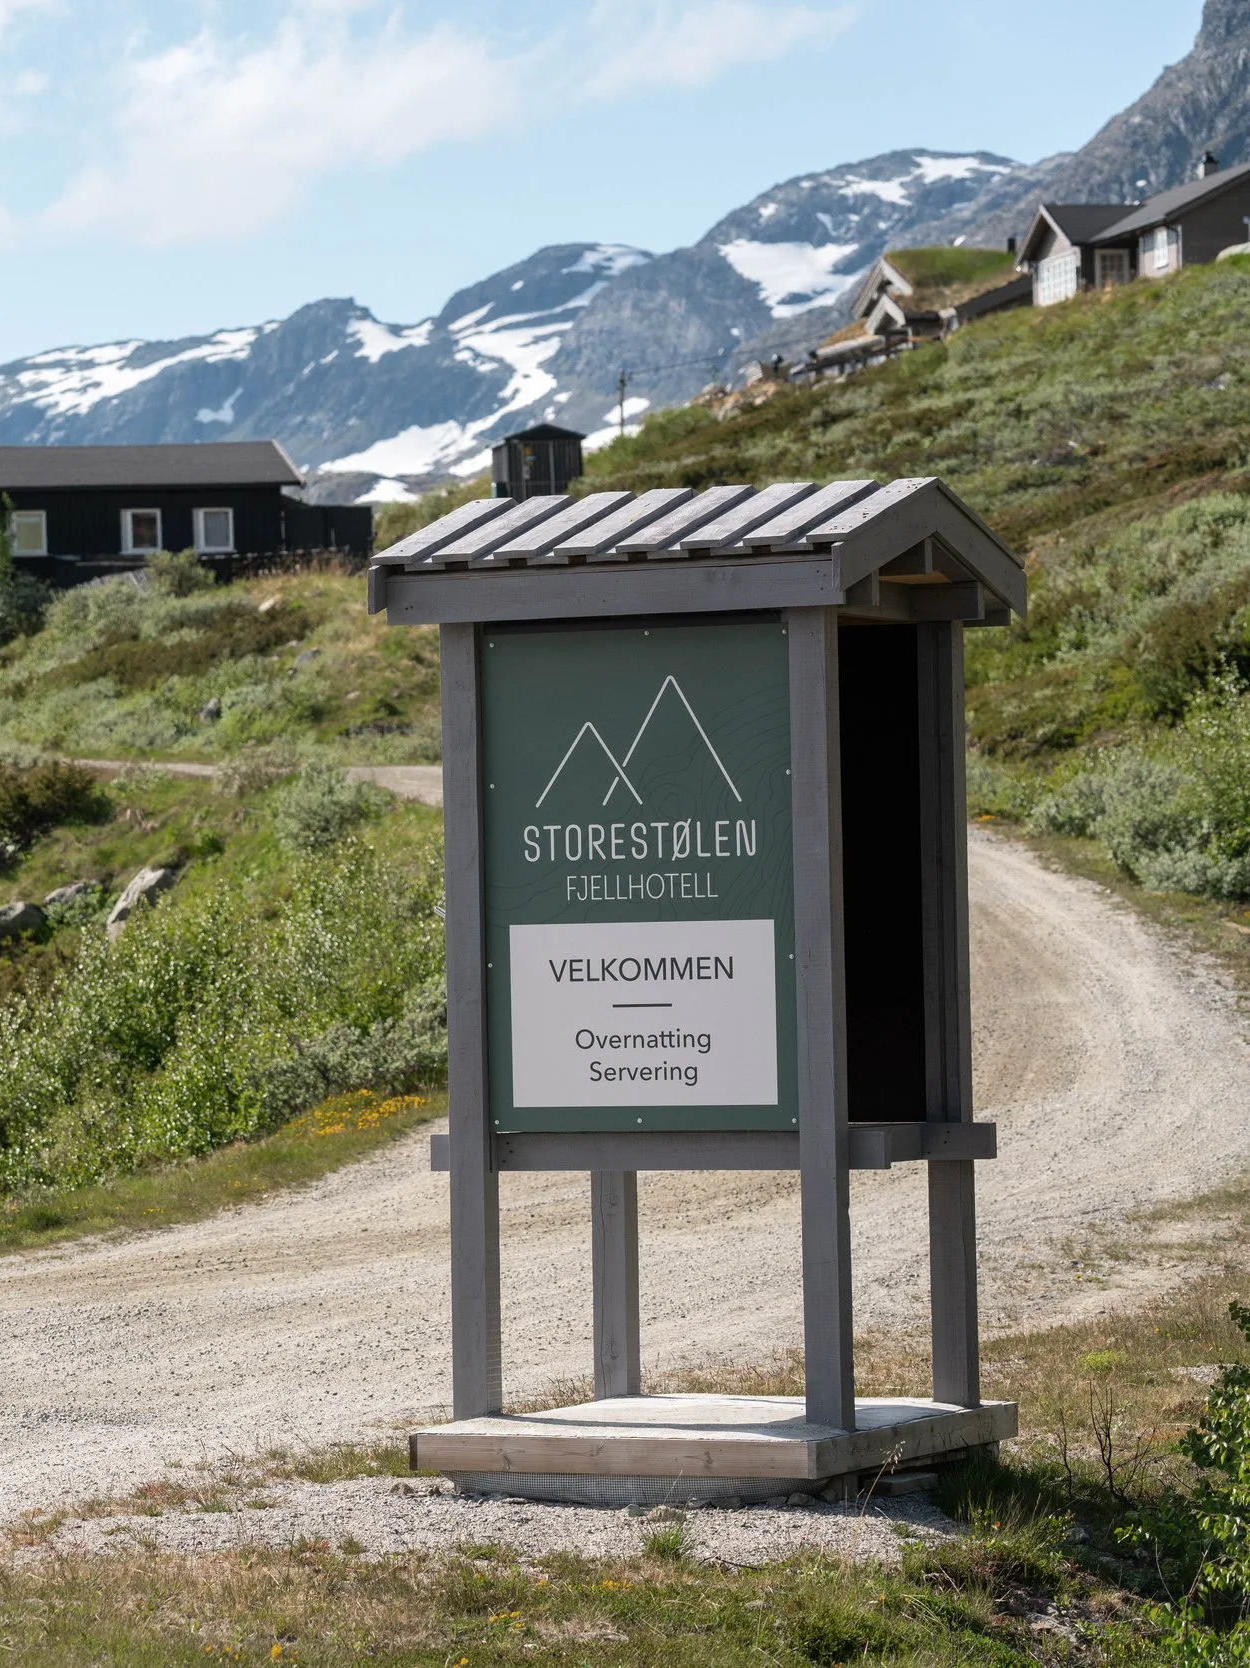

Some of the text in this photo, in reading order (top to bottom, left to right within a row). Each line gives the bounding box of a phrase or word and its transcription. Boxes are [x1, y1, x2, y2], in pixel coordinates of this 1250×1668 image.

[523, 818, 756, 862] STORESTØLEN
[566, 872, 718, 901] FJELLHOTELL
[549, 956, 734, 982] VELKOMMEN
[575, 1028, 711, 1054] Overnatting
[589, 1060, 698, 1086] Servering
